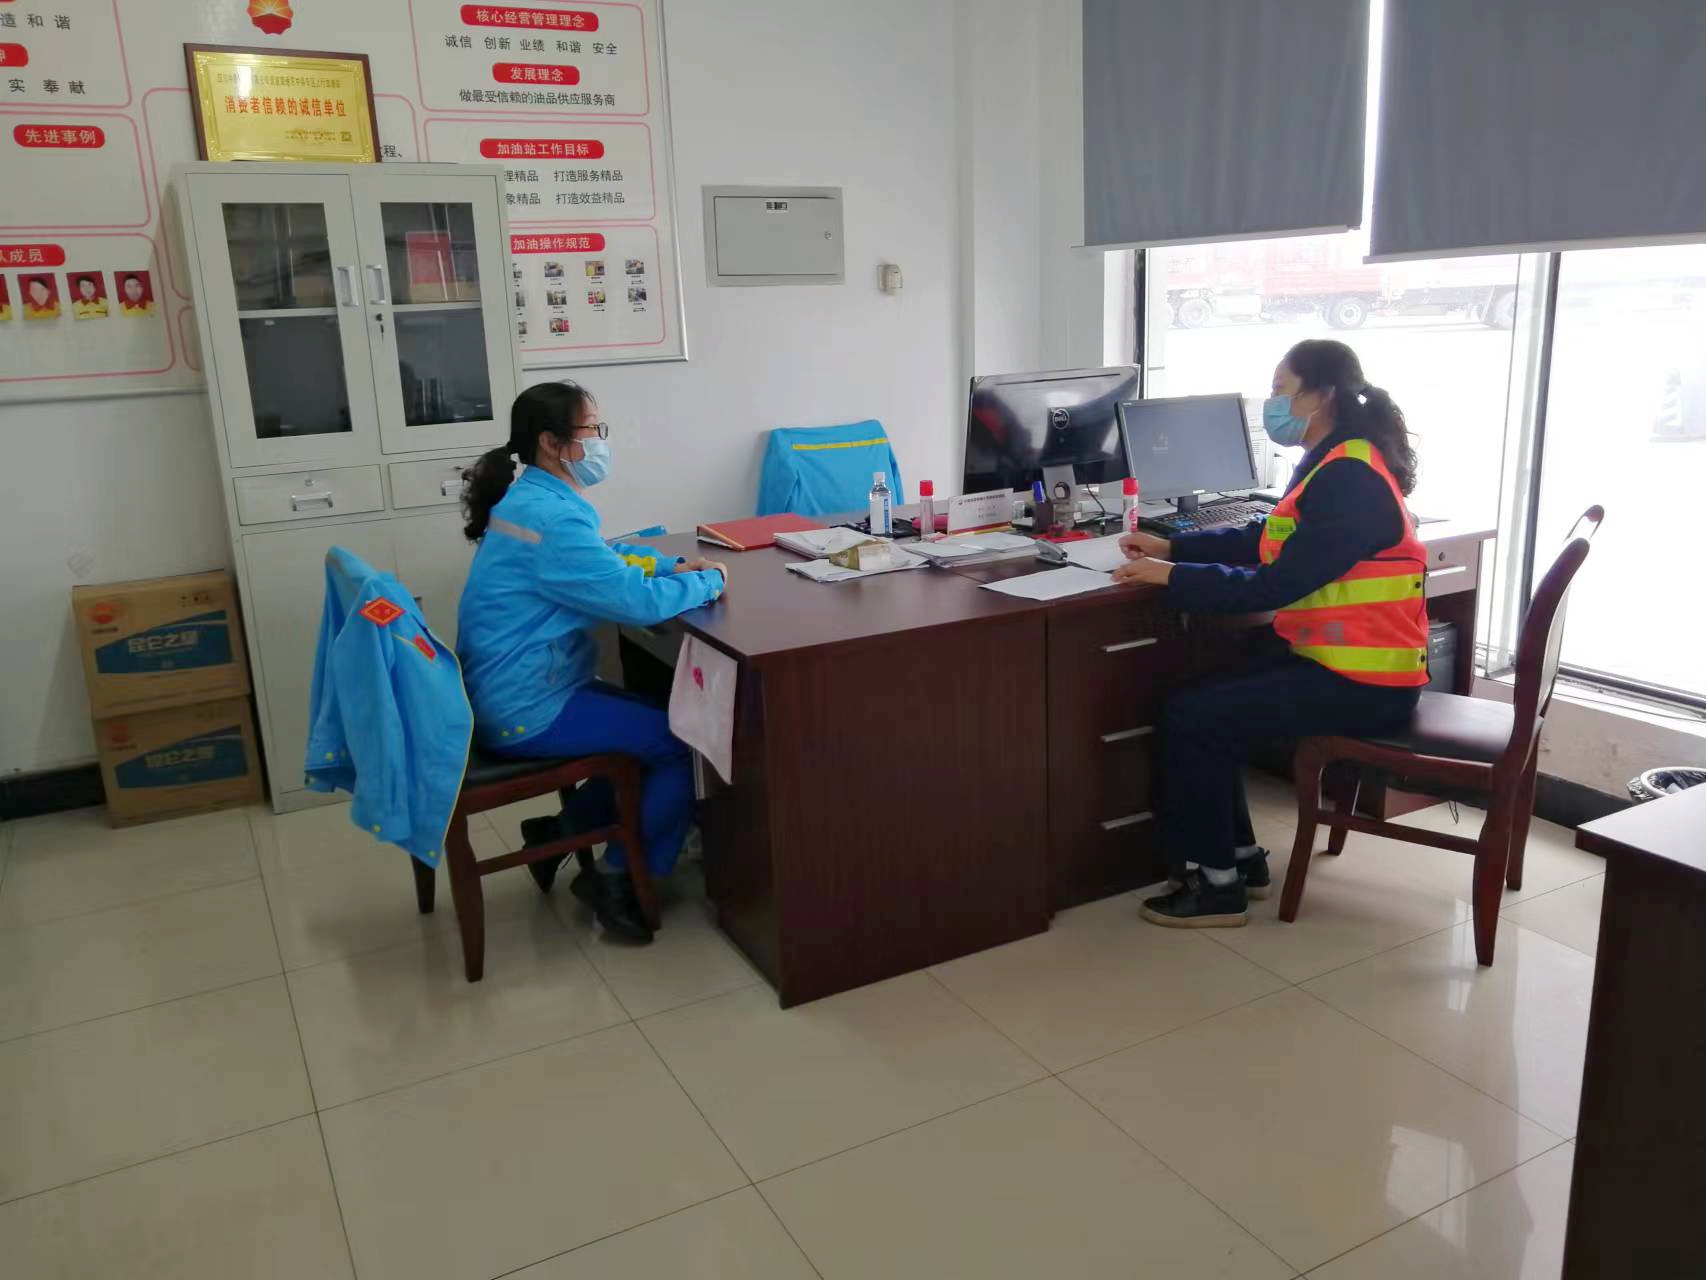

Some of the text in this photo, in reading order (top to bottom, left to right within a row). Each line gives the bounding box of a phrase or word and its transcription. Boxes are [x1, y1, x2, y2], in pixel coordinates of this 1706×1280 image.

[476, 9, 584, 27] 核心经营管理理念
[445, 35, 617, 55] 诚信 创新 业绩 和谐 安全
[510, 67, 564, 82] 发展理念
[459, 89, 615, 106] 做最受信赖的油品供应服务商
[225, 95, 347, 117] 消费者信赖的诚信单位
[25, 128, 96, 144] 先进事例
[497, 143, 589, 156] 加油站工作目标
[554, 170, 623, 182] 打造服务精品
[556, 193, 625, 205] 打造效益精品
[513, 236, 591, 250] 加油操作规范
